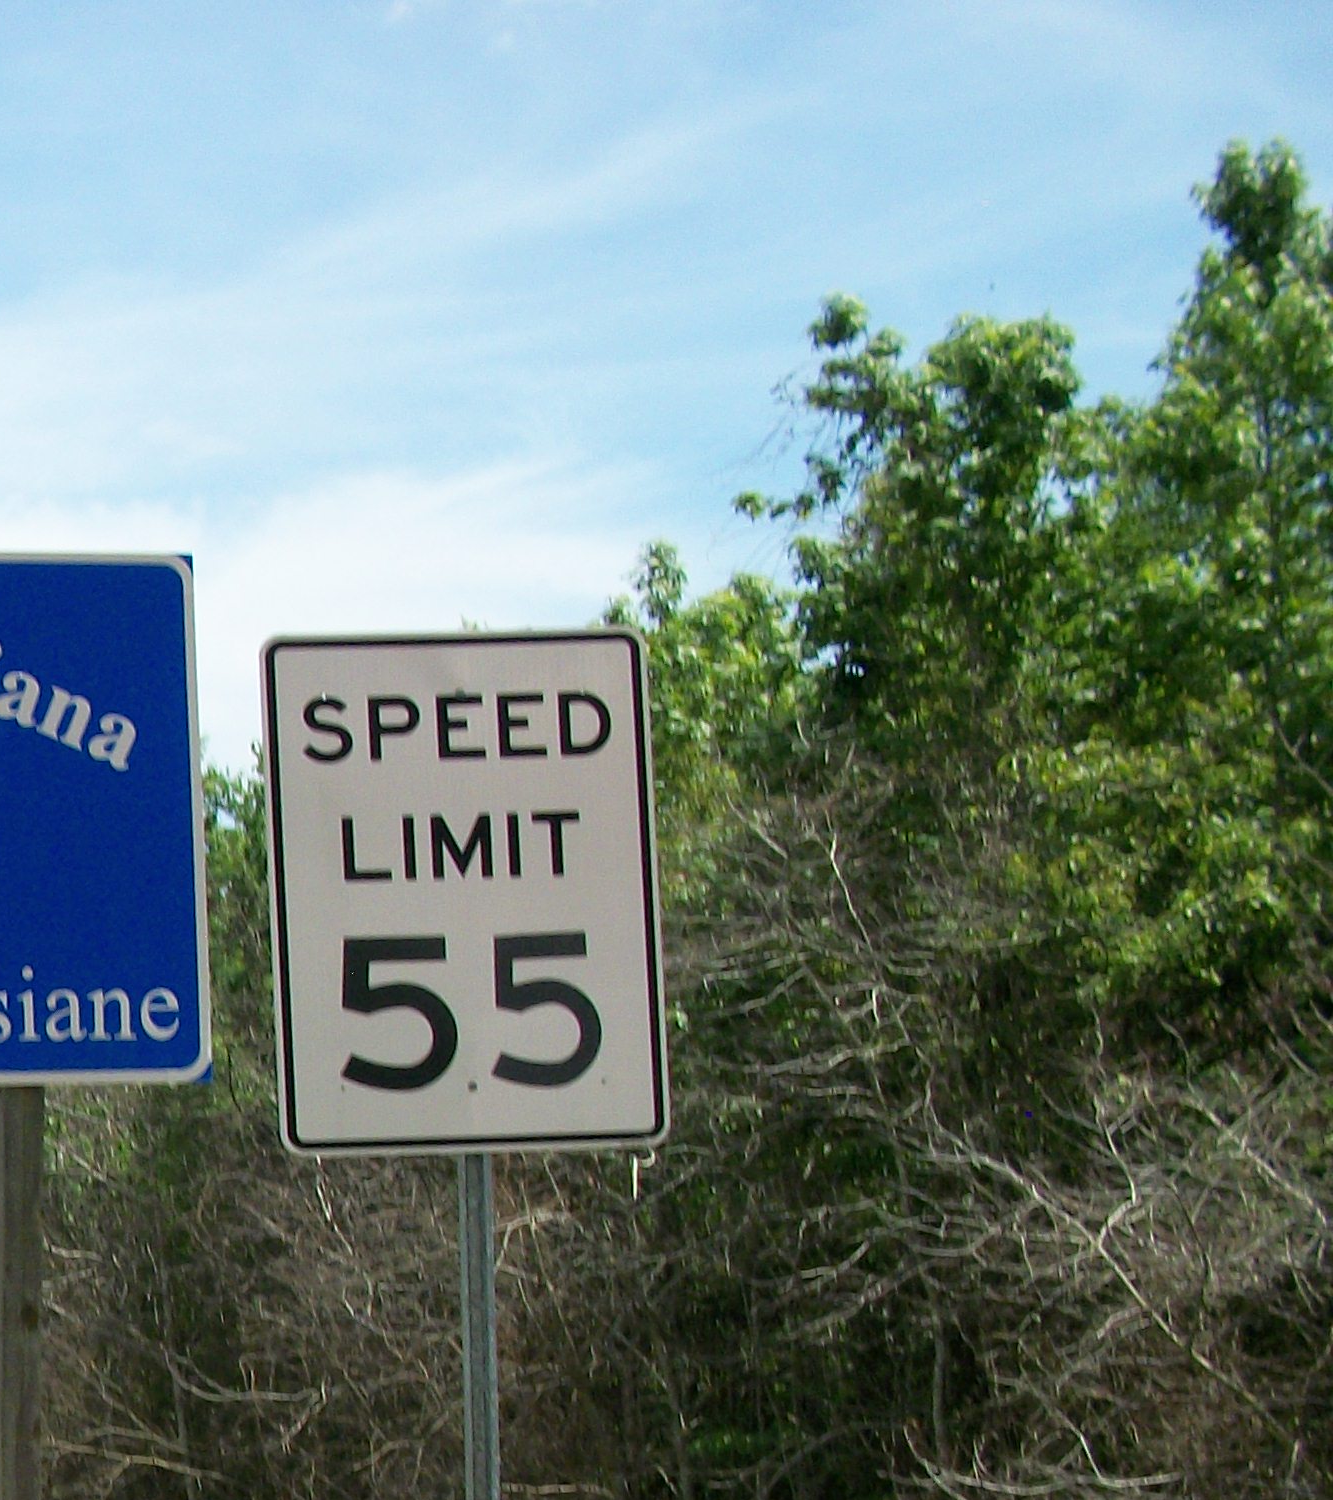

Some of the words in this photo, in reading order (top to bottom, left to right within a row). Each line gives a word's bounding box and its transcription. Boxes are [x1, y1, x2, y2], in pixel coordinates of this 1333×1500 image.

[303, 691, 612, 763] SPEED
[341, 811, 580, 881] LIMIT
[341, 930, 603, 1091] 55
